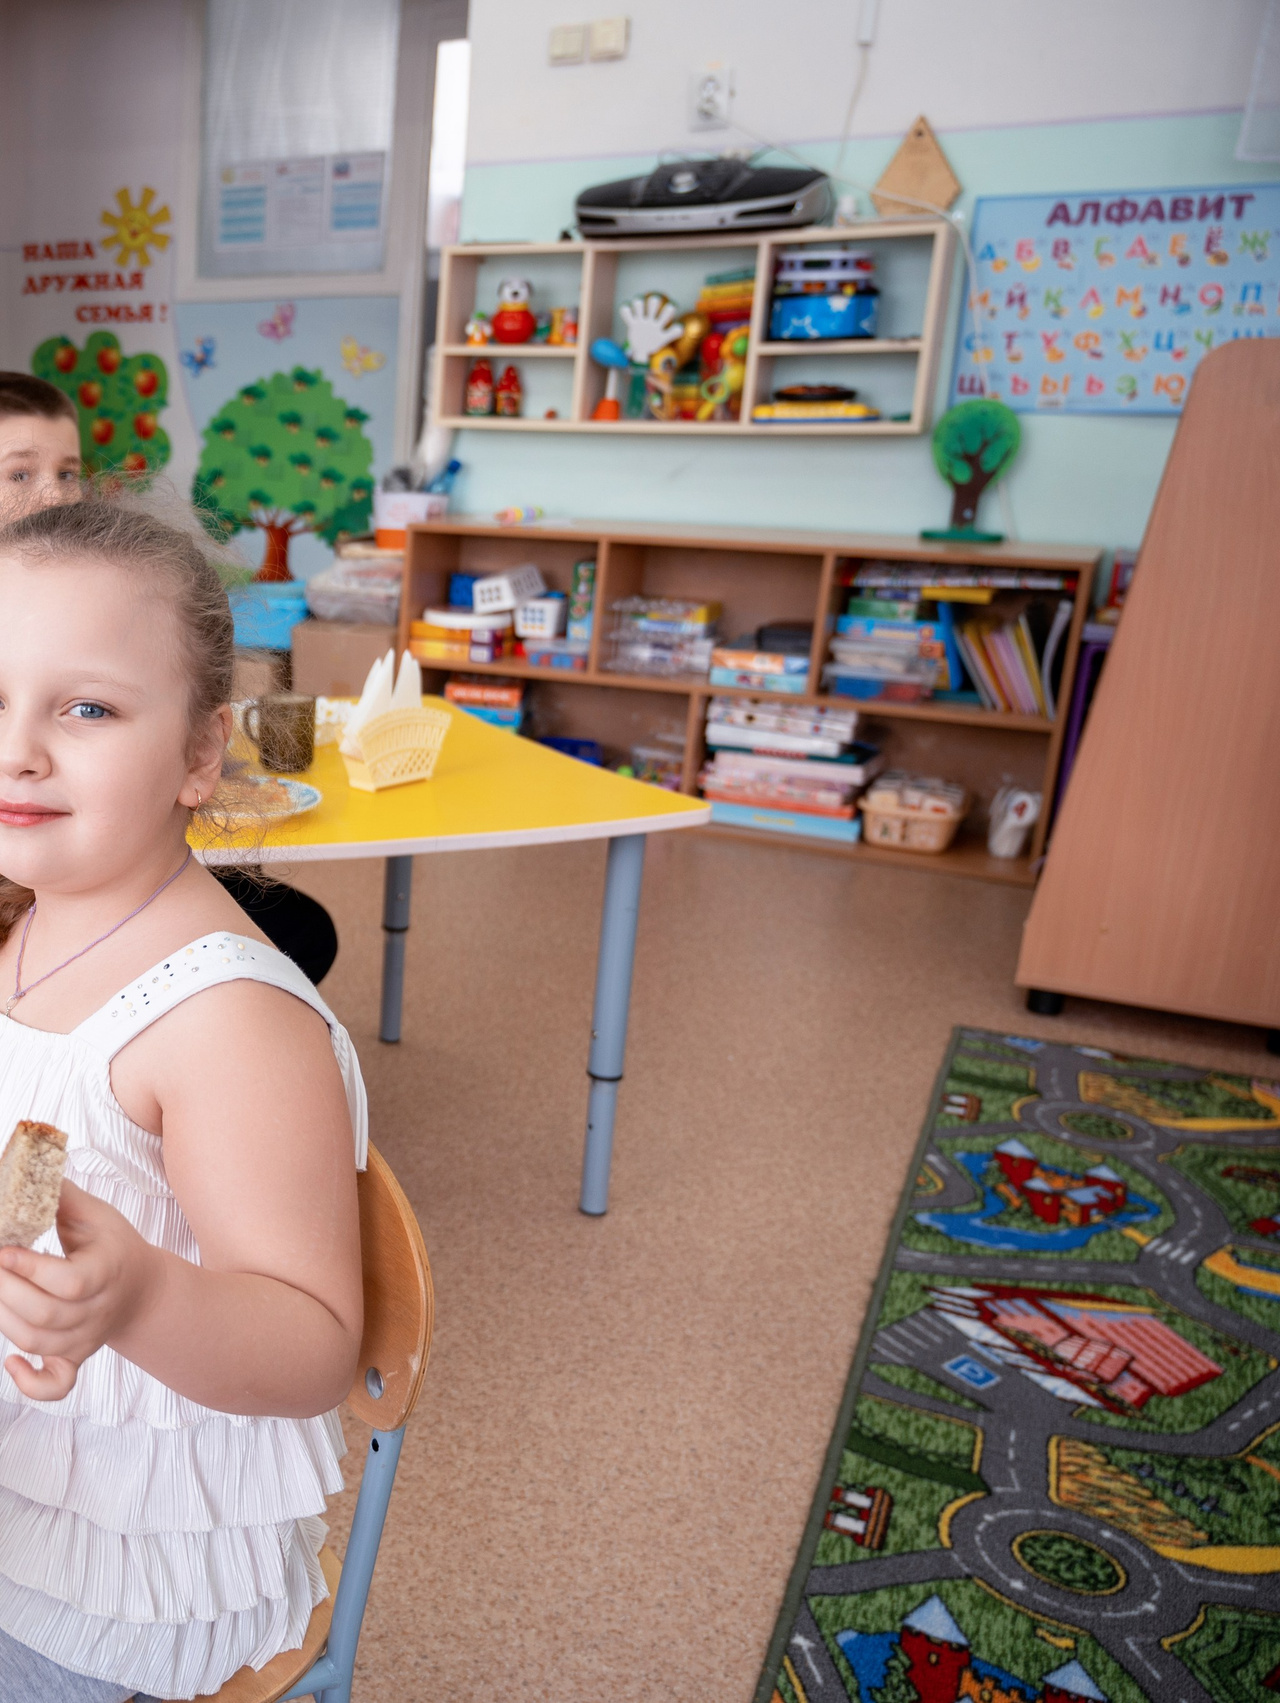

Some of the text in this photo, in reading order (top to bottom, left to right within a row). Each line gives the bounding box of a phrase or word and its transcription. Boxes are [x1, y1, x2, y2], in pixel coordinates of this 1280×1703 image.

[1046, 193, 1255, 227] АЛФАВИТ
[23, 241, 95, 262] НАША
[23, 271, 143, 294] ДРУЖНАЯ
